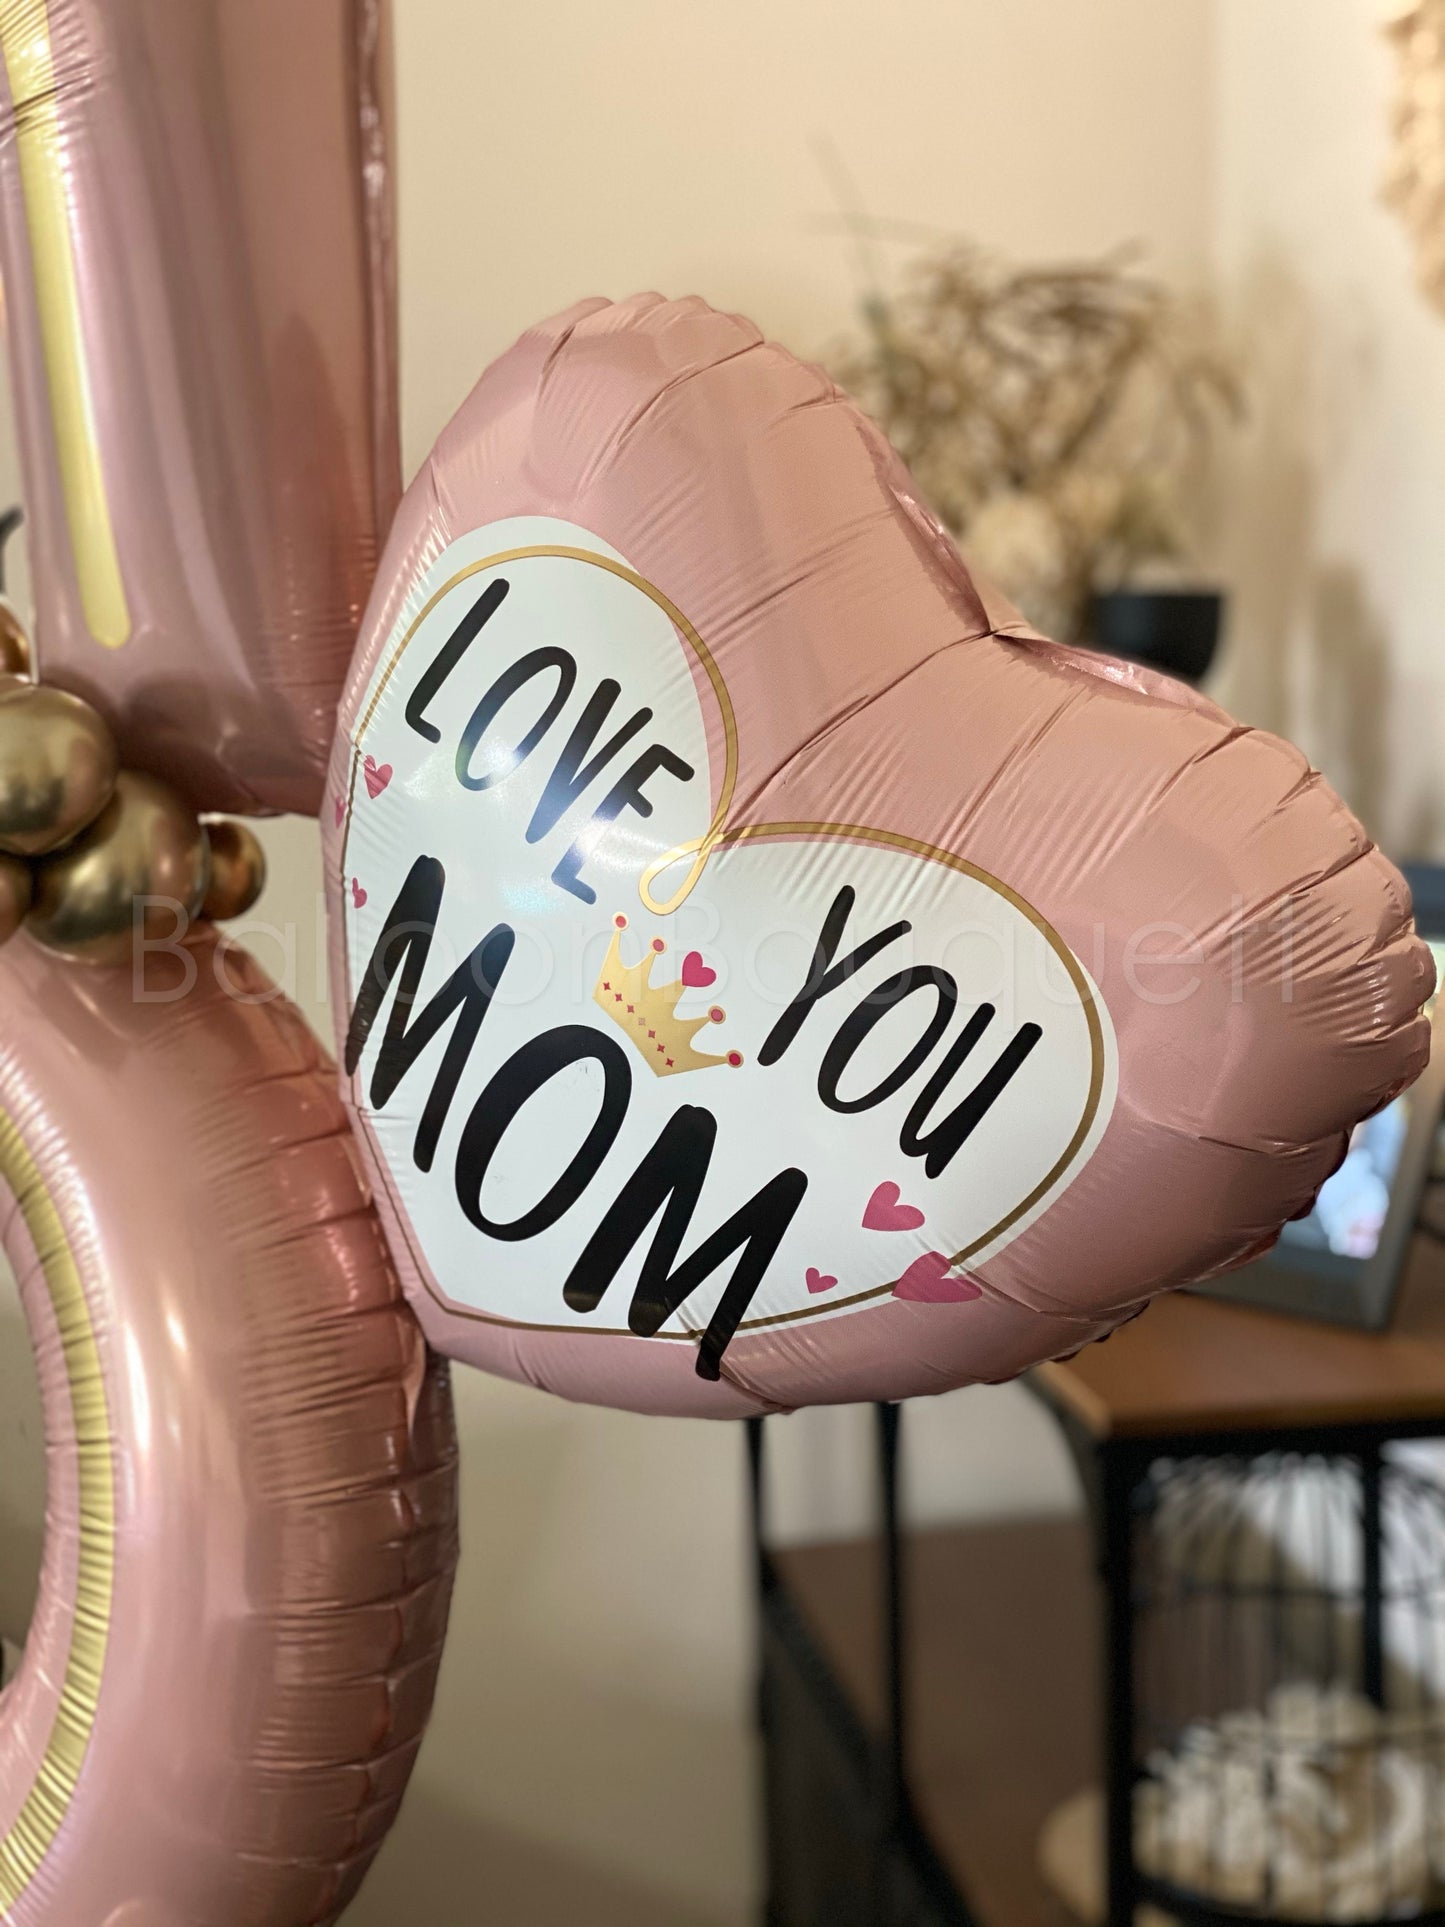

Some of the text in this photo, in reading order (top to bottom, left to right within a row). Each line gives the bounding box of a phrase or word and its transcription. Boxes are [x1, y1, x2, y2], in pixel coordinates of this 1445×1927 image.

[344, 854, 809, 1380] MOM
[404, 578, 1043, 1179] LOVE YOU
